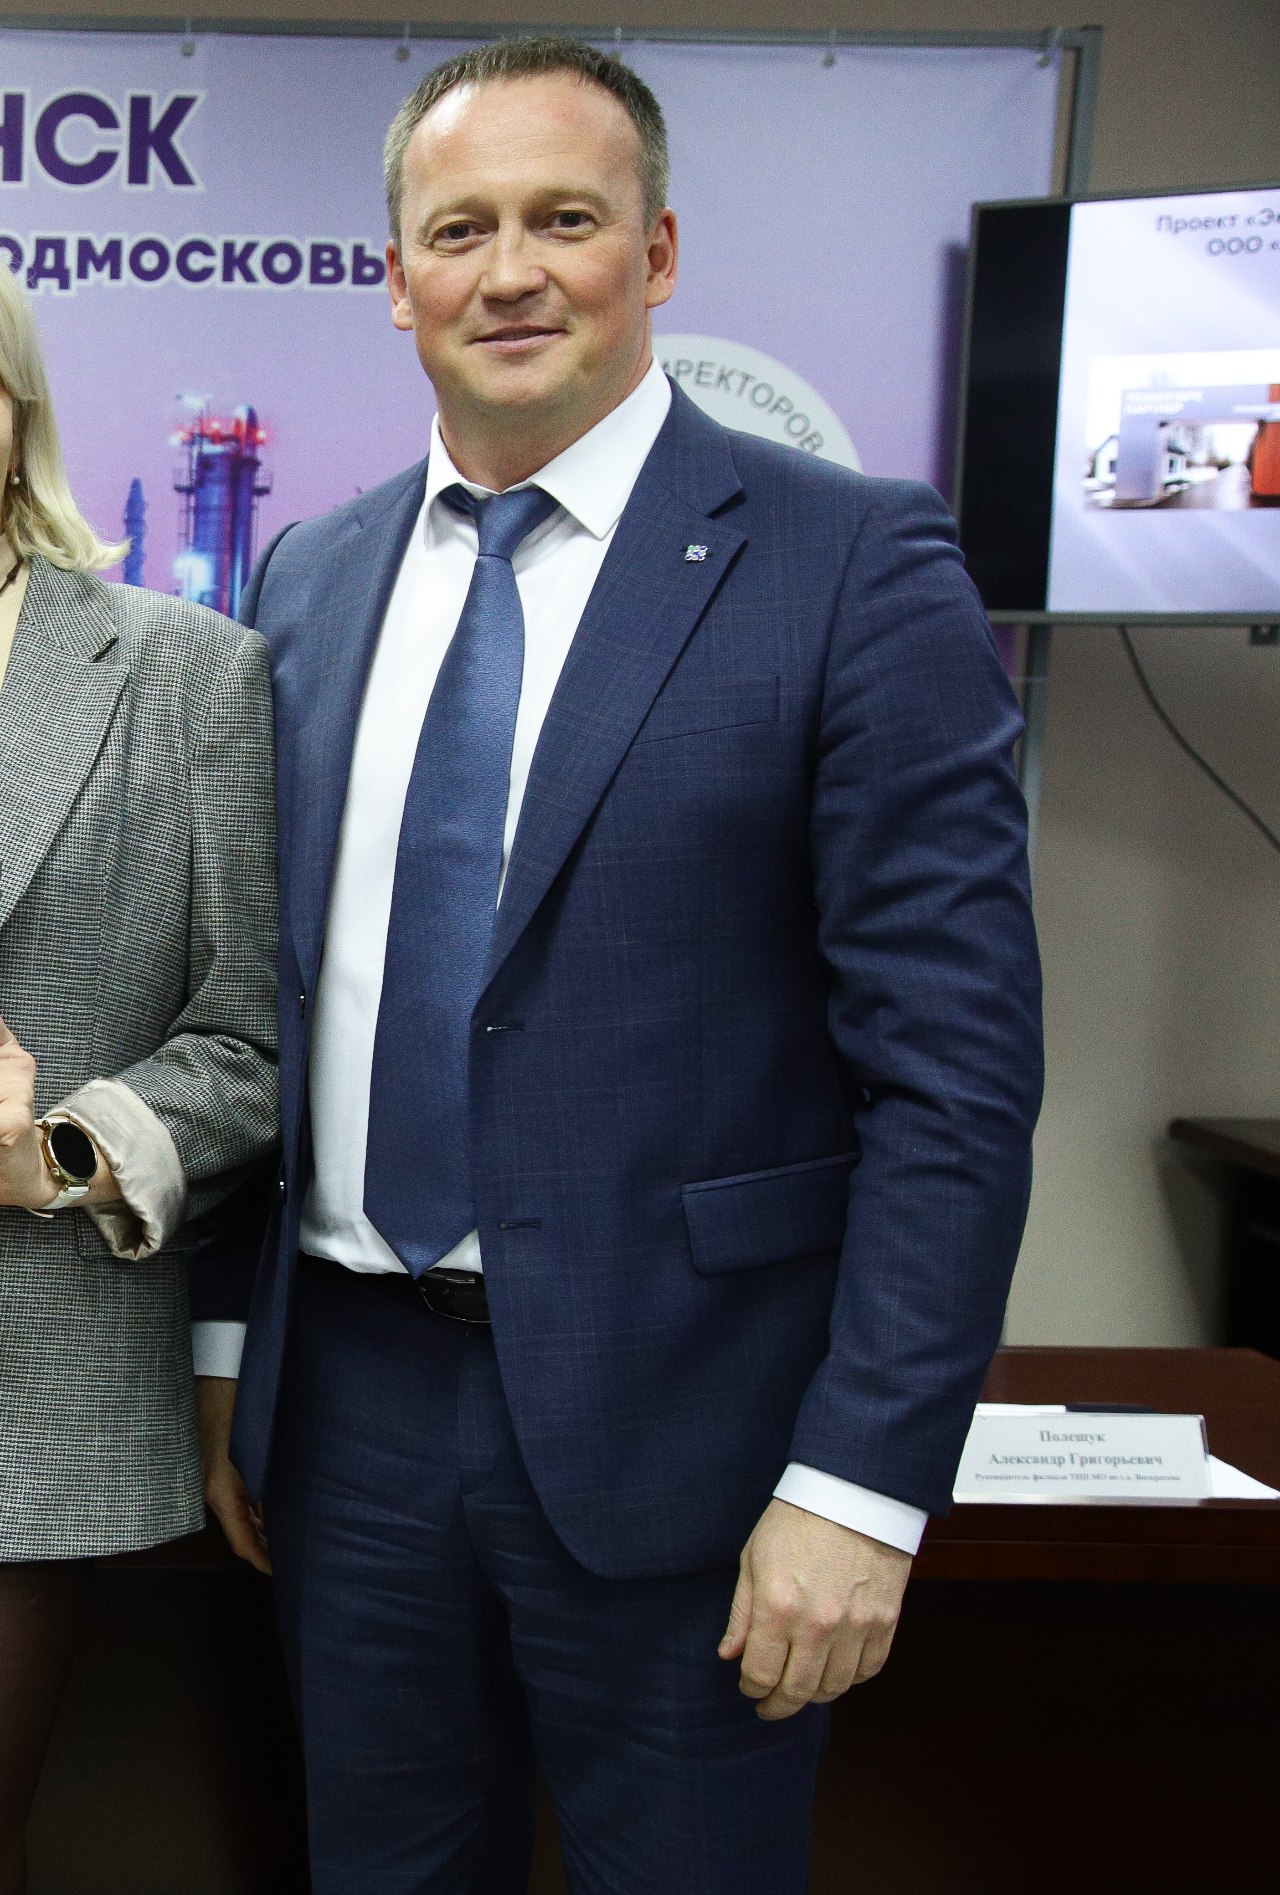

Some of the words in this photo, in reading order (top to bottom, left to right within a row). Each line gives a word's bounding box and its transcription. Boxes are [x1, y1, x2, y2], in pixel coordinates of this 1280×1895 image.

[1156, 215, 1237, 234] Проект
[1246, 208, 1280, 227] «Э
[1208, 235, 1262, 256] ООО
[662, 358, 826, 453] РЕКТОРОВ
[1039, 1429, 1106, 1445] Полещук
[989, 1453, 1065, 1468] Александр
[1069, 1452, 1163, 1469] Григорьевич
